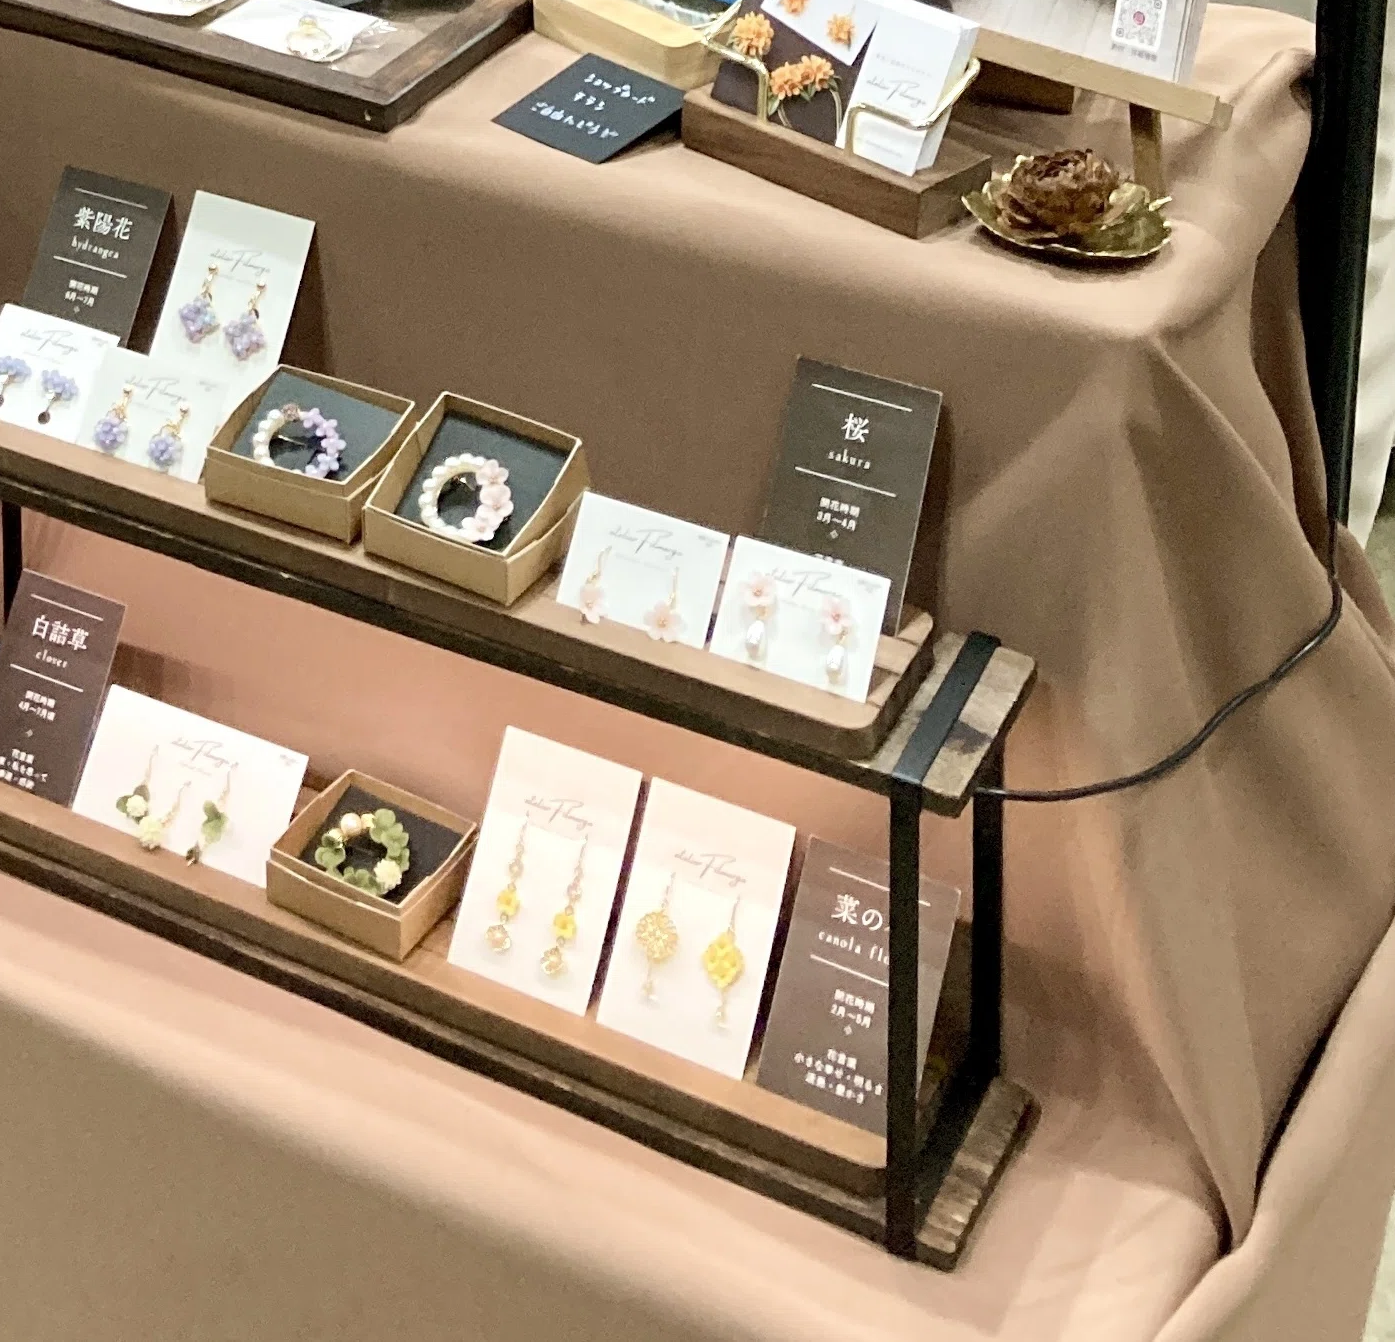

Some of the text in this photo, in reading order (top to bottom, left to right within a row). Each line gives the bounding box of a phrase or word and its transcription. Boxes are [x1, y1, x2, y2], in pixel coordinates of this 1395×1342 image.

[72, 204, 135, 242] 紫陽花
[70, 234, 120, 261] hydrangea
[840, 412, 870, 444] 桜
[827, 448, 872, 471] sakura
[31, 614, 91, 652] 白詰草
[35, 650, 68, 670] clover
[830, 892, 890, 932] 菜の
[817, 928, 862, 954] canola
